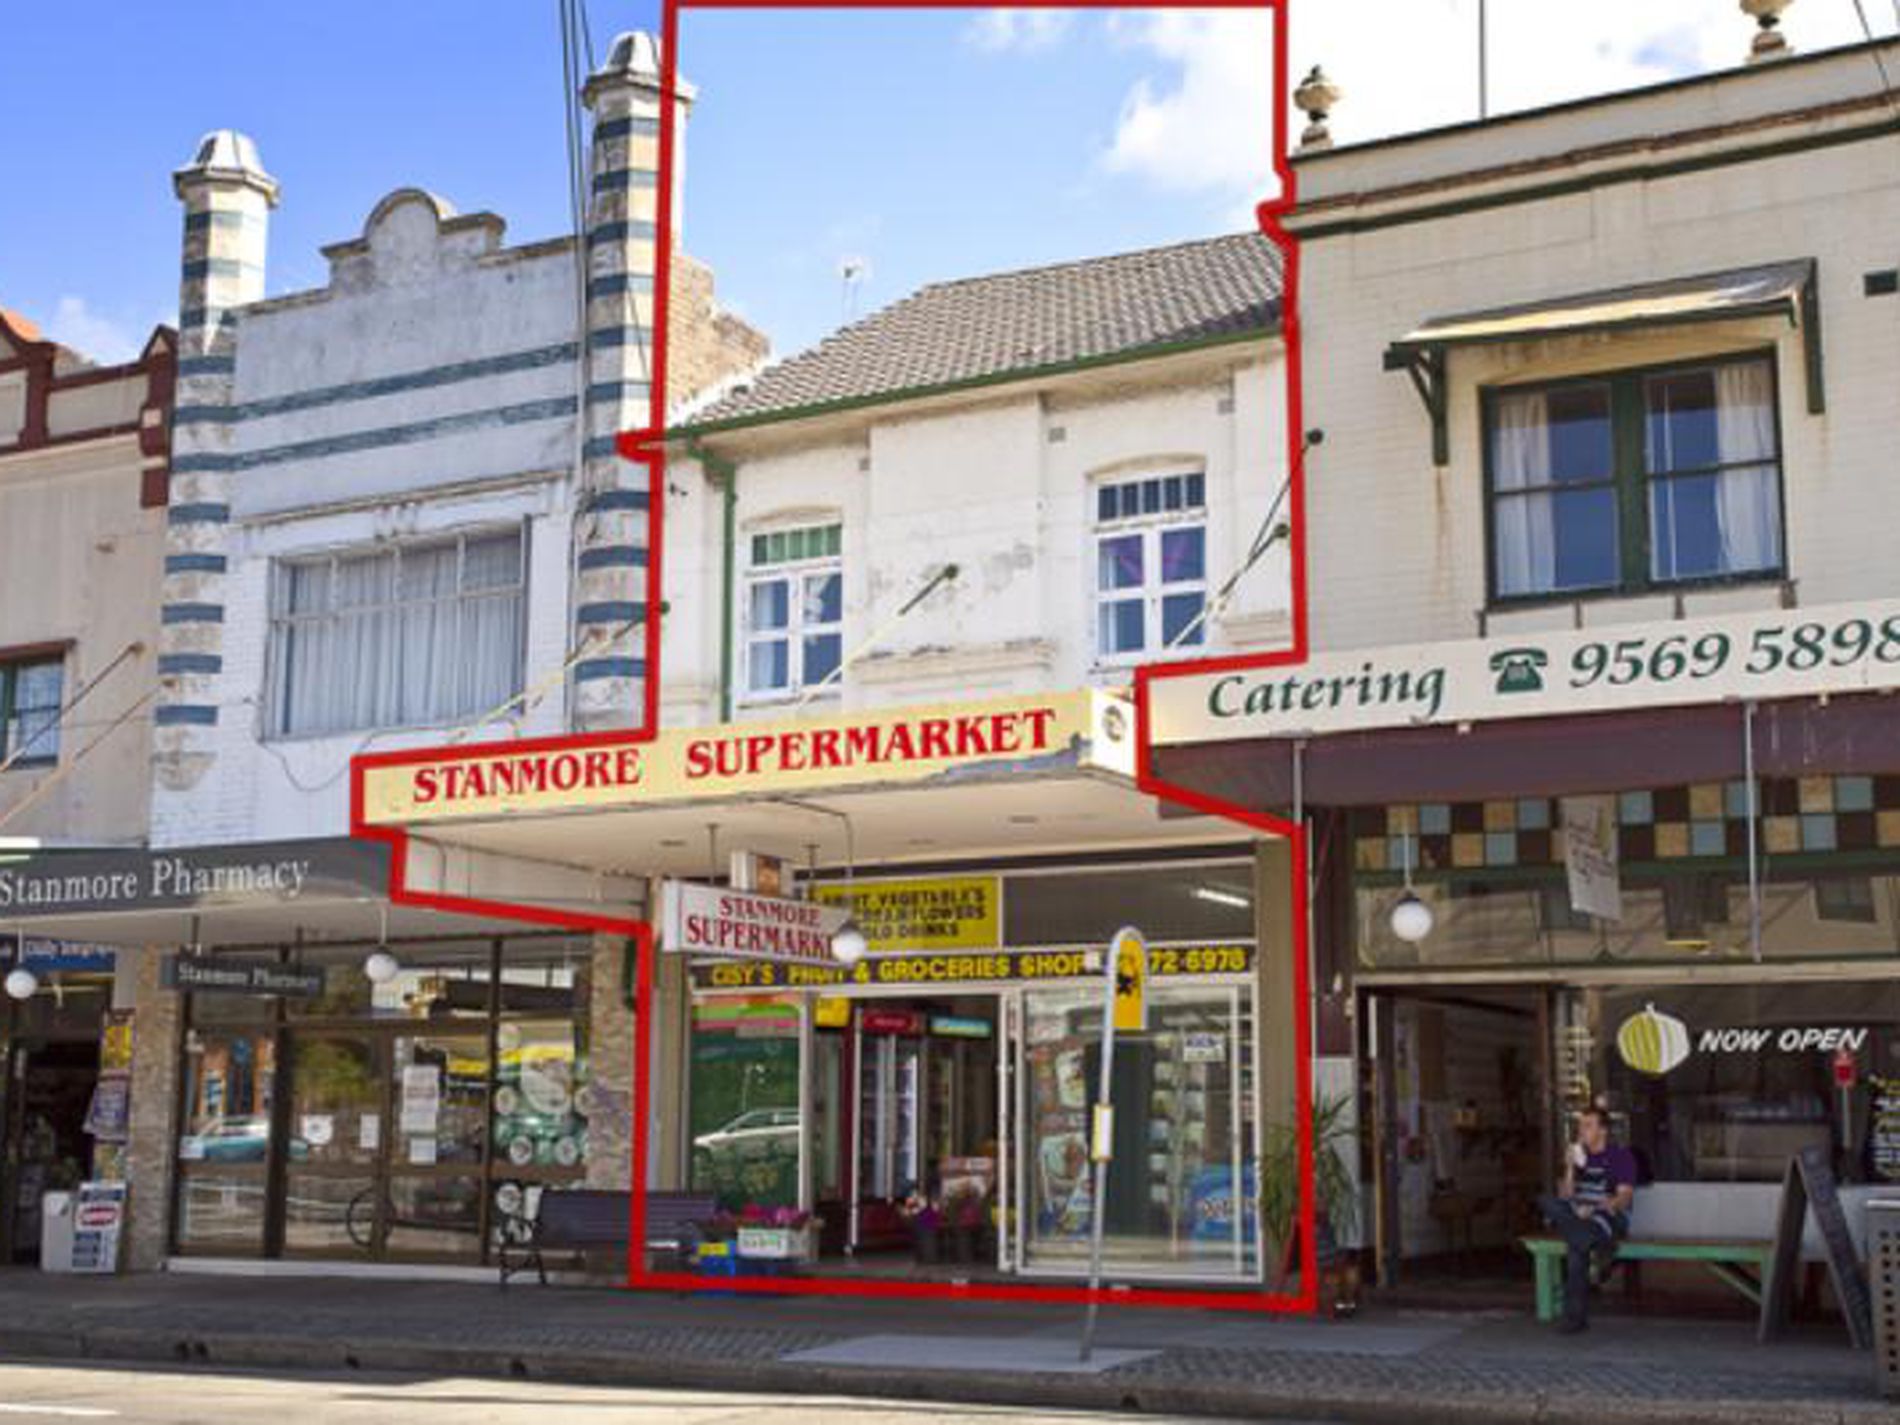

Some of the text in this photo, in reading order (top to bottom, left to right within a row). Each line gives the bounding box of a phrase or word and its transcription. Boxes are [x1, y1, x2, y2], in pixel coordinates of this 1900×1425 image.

[1208, 614, 1900, 717] Catering 9569 5898
[413, 708, 1055, 803] STANMORE SUPERMARKET
[0, 857, 310, 905] Stanmore Pharmacy
[719, 896, 822, 927] STANMORE
[879, 957, 1010, 981] GROCERIES
[1020, 953, 1085, 977] SHOP
[1699, 1027, 1869, 1052] NOW OPEN
